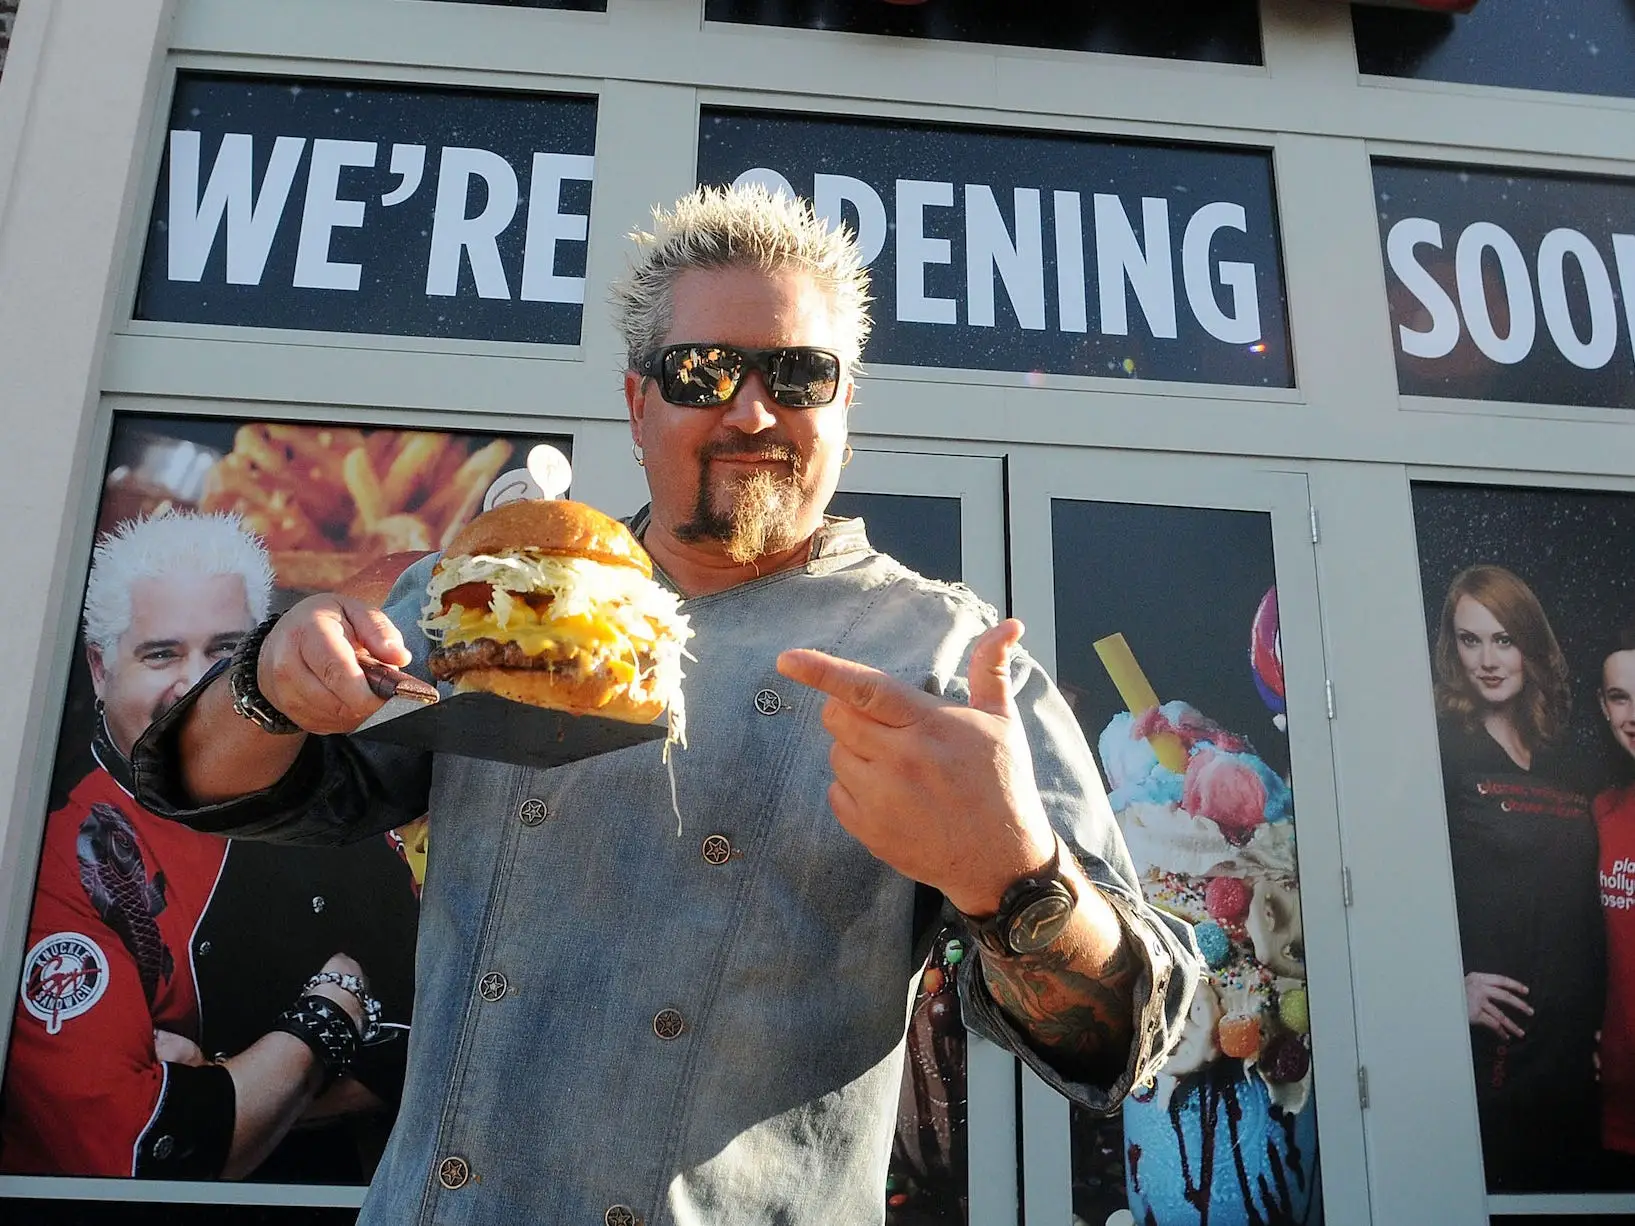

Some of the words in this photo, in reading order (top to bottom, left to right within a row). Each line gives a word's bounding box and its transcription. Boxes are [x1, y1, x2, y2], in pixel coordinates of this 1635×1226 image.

[167, 130, 595, 304] WE'RE
[730, 167, 1262, 344] PENING
[36, 942, 91, 967] KNUCKLE
[35, 984, 92, 1010] SANDWICH
